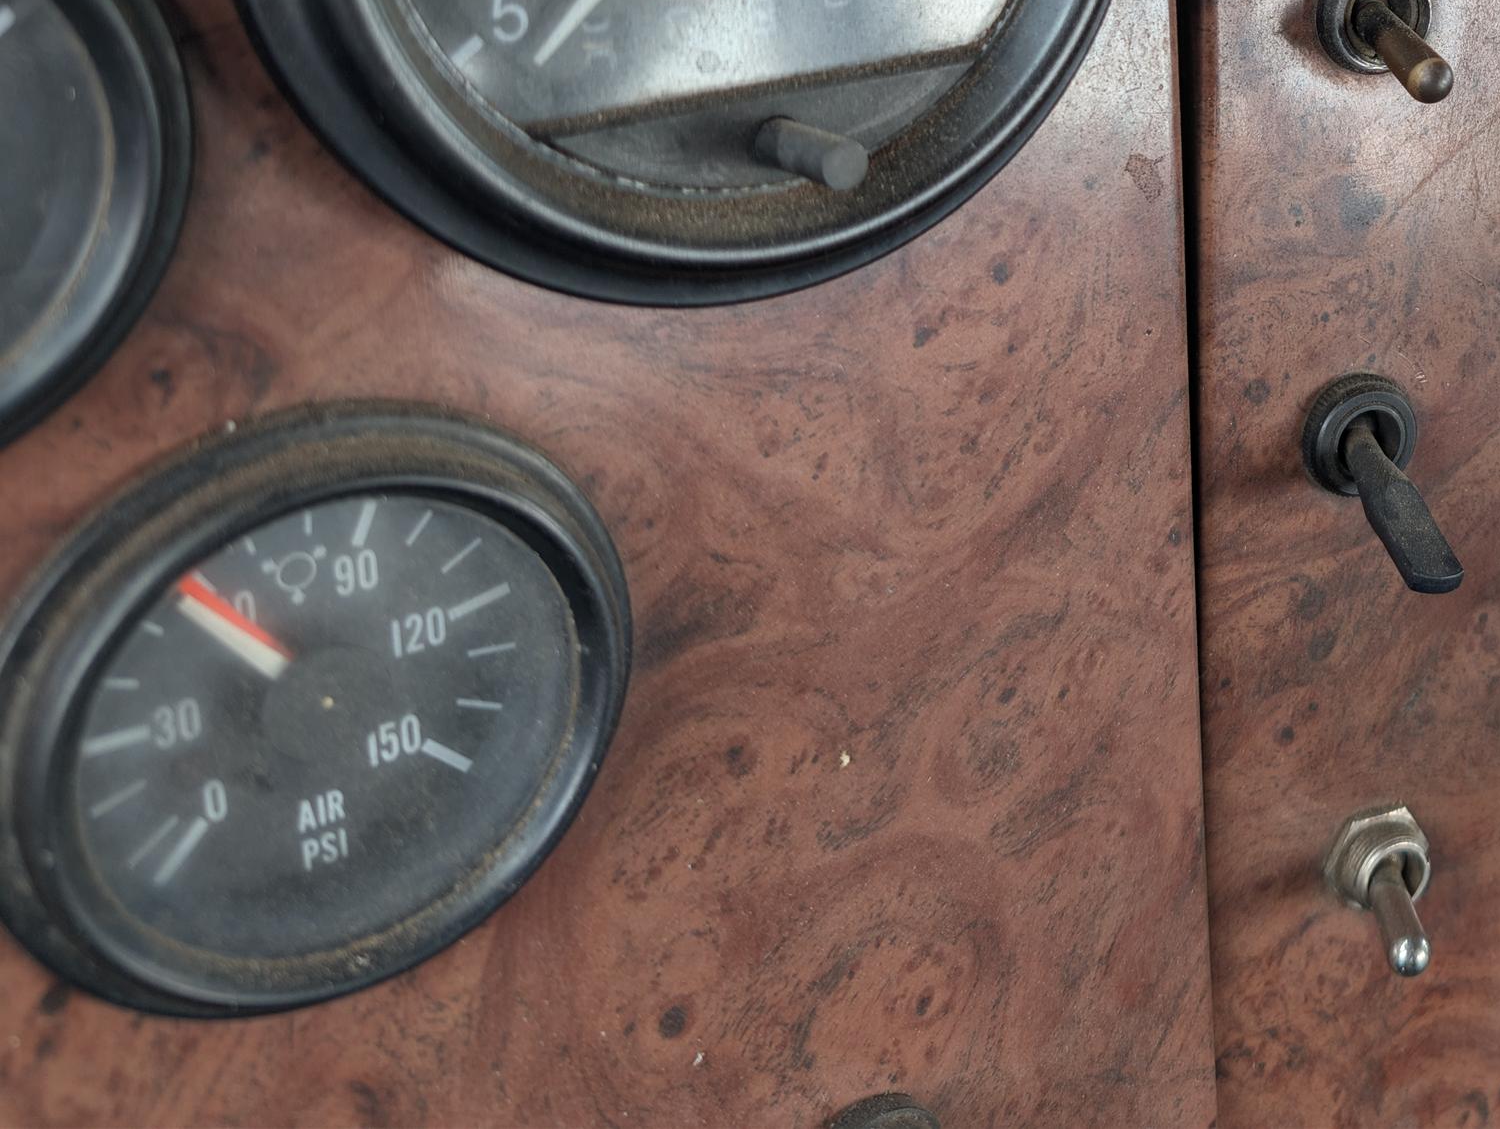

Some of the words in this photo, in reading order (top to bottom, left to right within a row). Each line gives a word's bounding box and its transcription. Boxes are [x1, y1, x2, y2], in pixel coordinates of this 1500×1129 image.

[334, 550, 380, 597] 90
[391, 607, 447, 659] 120
[151, 698, 202, 750] 30
[367, 714, 424, 768] 150
[204, 779, 228, 823] 0
[297, 789, 346, 833] AIR
[302, 831, 348, 871] PSI
